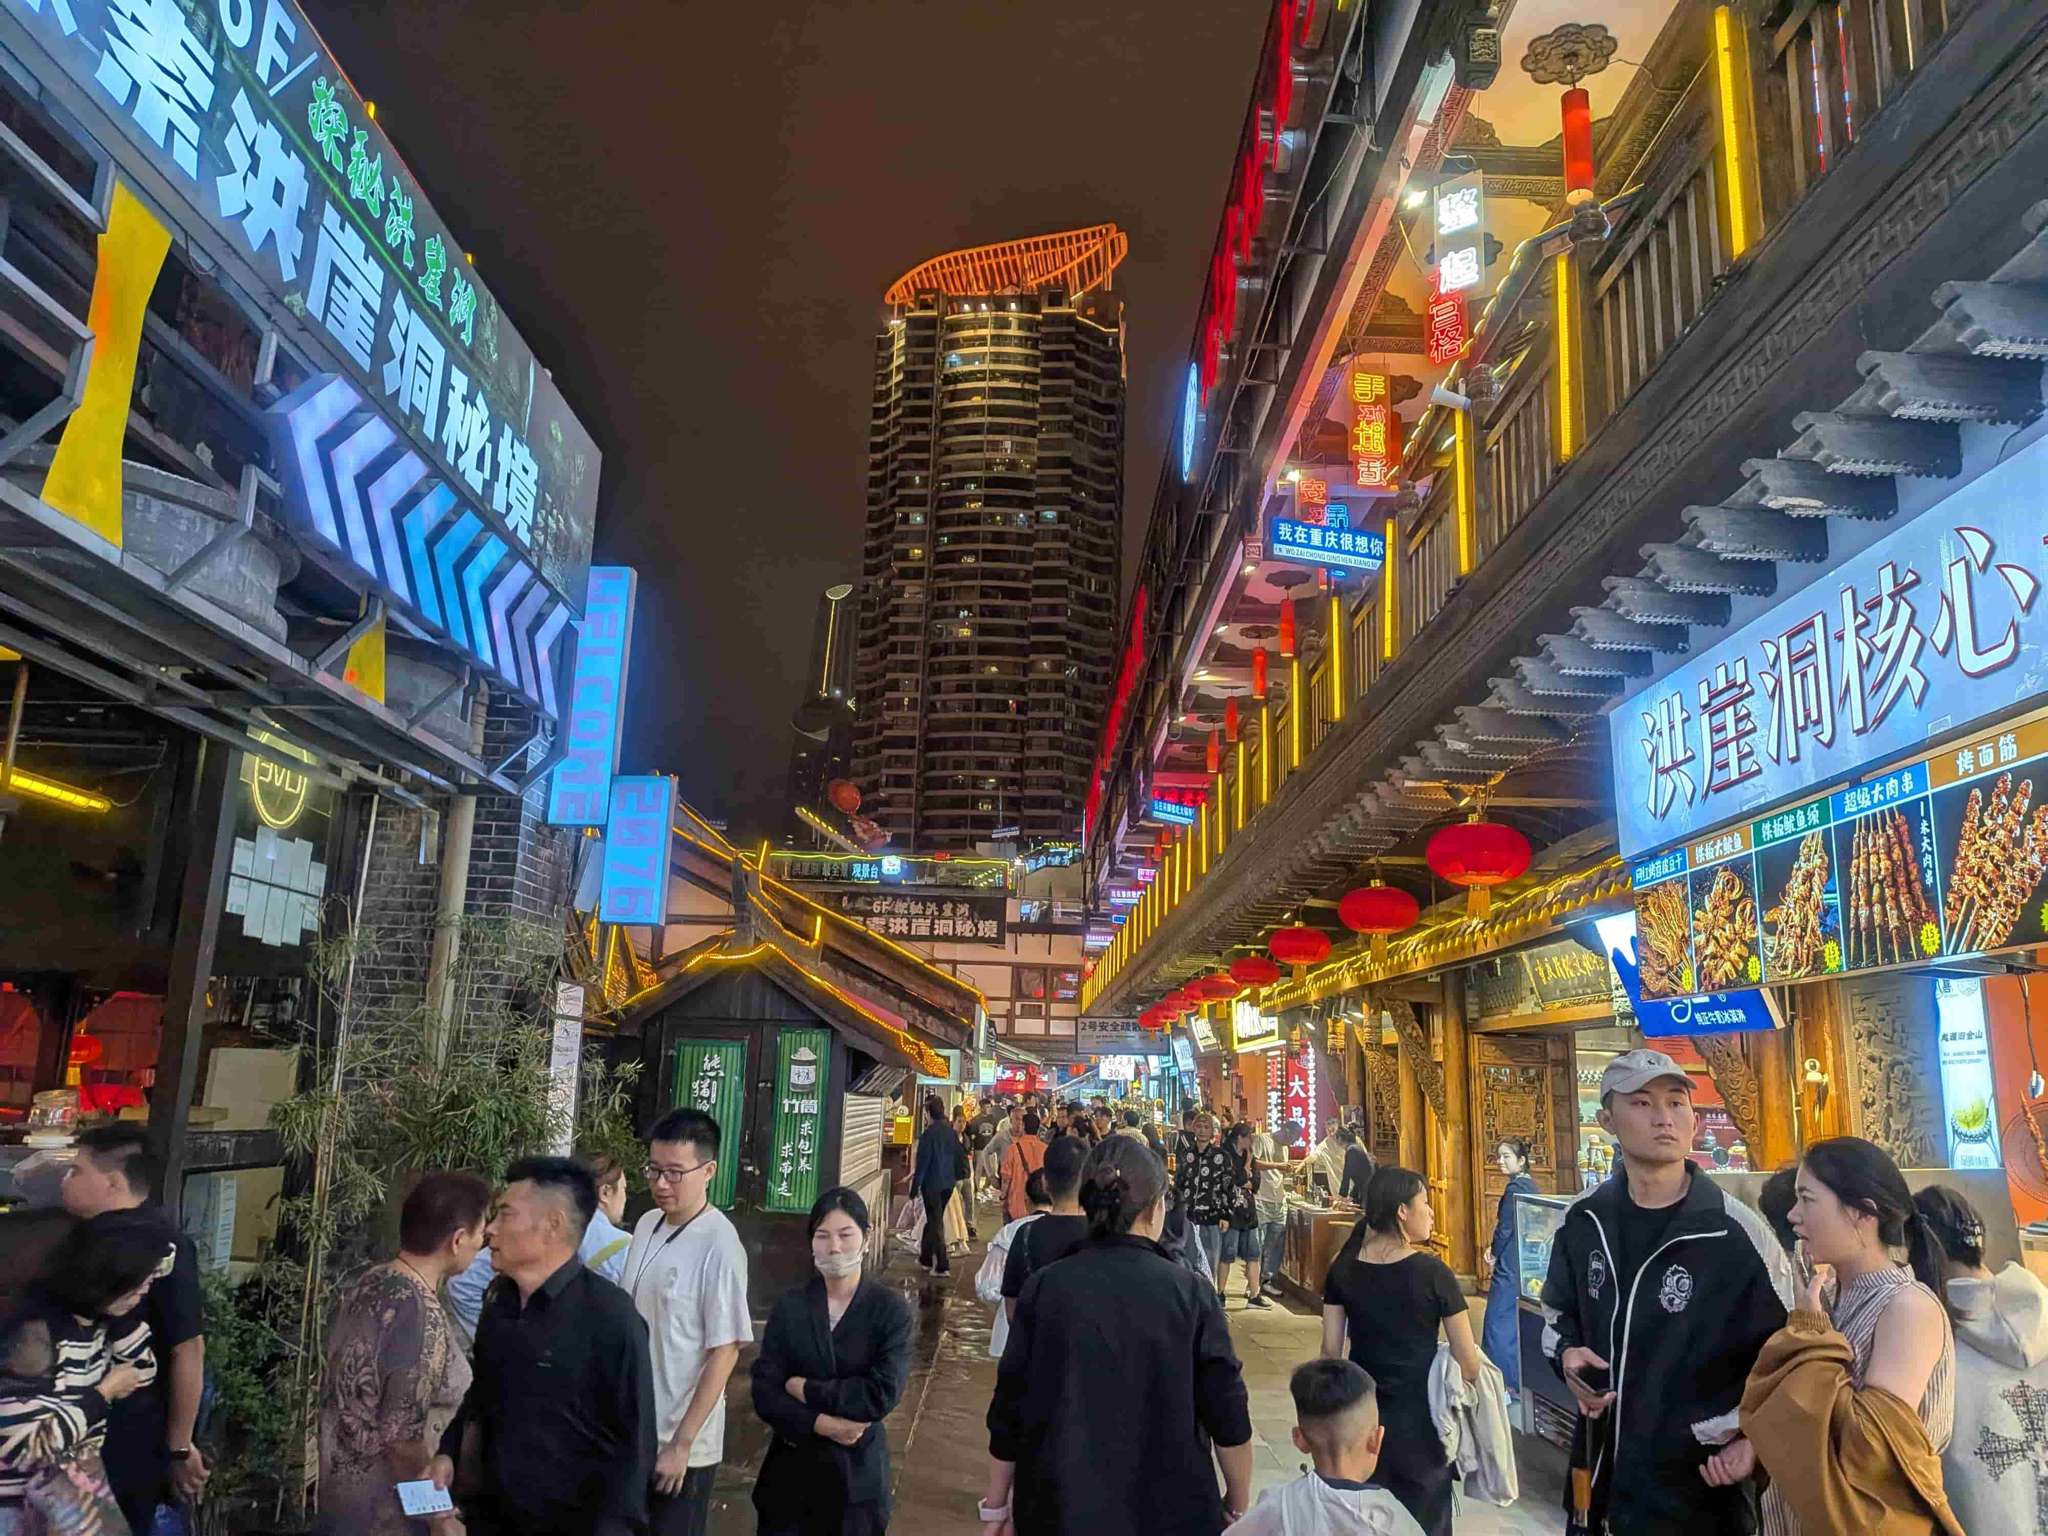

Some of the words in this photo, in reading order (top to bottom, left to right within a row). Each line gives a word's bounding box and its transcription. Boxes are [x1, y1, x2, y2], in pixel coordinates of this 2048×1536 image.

[26, 0, 540, 549] 雾洪崖洞秘境
[1278, 522, 1384, 557] 我在重庆很想你
[1641, 526, 2037, 817] 洪崖洞核心
[1956, 734, 2017, 776] 烤面筋
[1844, 772, 1914, 814] 超级大肉串
[1761, 804, 1820, 842] 铁板鱿鱼须
[1925, 928, 1935, 939] 15
[782, 1098, 818, 1114] 竹筒
[777, 1142, 794, 1196] 求带走
